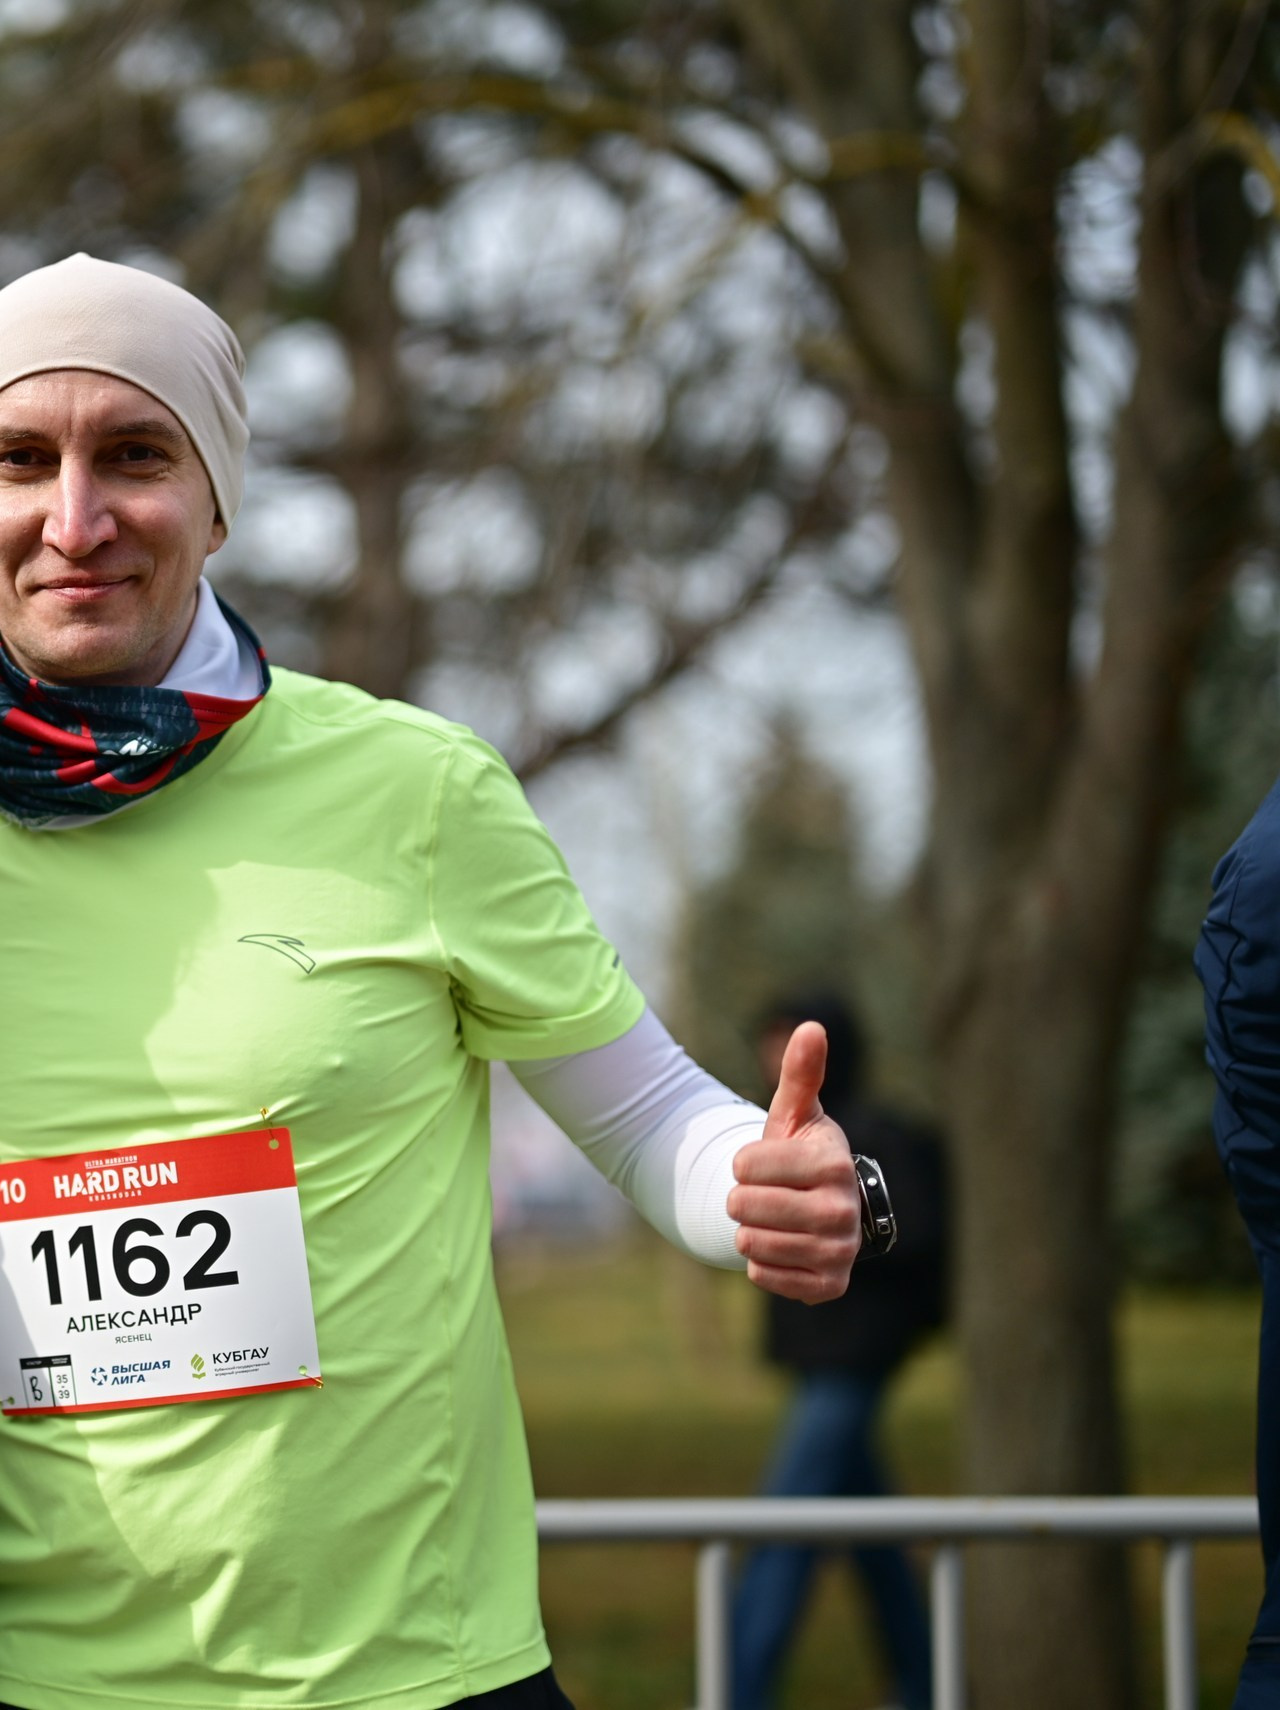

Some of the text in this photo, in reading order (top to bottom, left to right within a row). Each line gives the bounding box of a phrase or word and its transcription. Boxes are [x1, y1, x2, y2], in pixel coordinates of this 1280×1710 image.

[85, 1155, 138, 1168] ULTRA MARATHON
[53, 1161, 178, 1199] HARD RUN
[89, 1190, 143, 1202] KRASNODAR
[30, 1209, 239, 1305] 1162
[66, 1302, 203, 1334] АЛЕКСАНДР
[114, 1333, 153, 1344] ЯСЕНЕЦ
[212, 1346, 269, 1364] КУБГАУ
[111, 1360, 171, 1374] ВЫСШАЯ
[56, 1374, 68, 1384] 35
[111, 1374, 146, 1386] ЛИГА
[58, 1390, 70, 1399] 39
